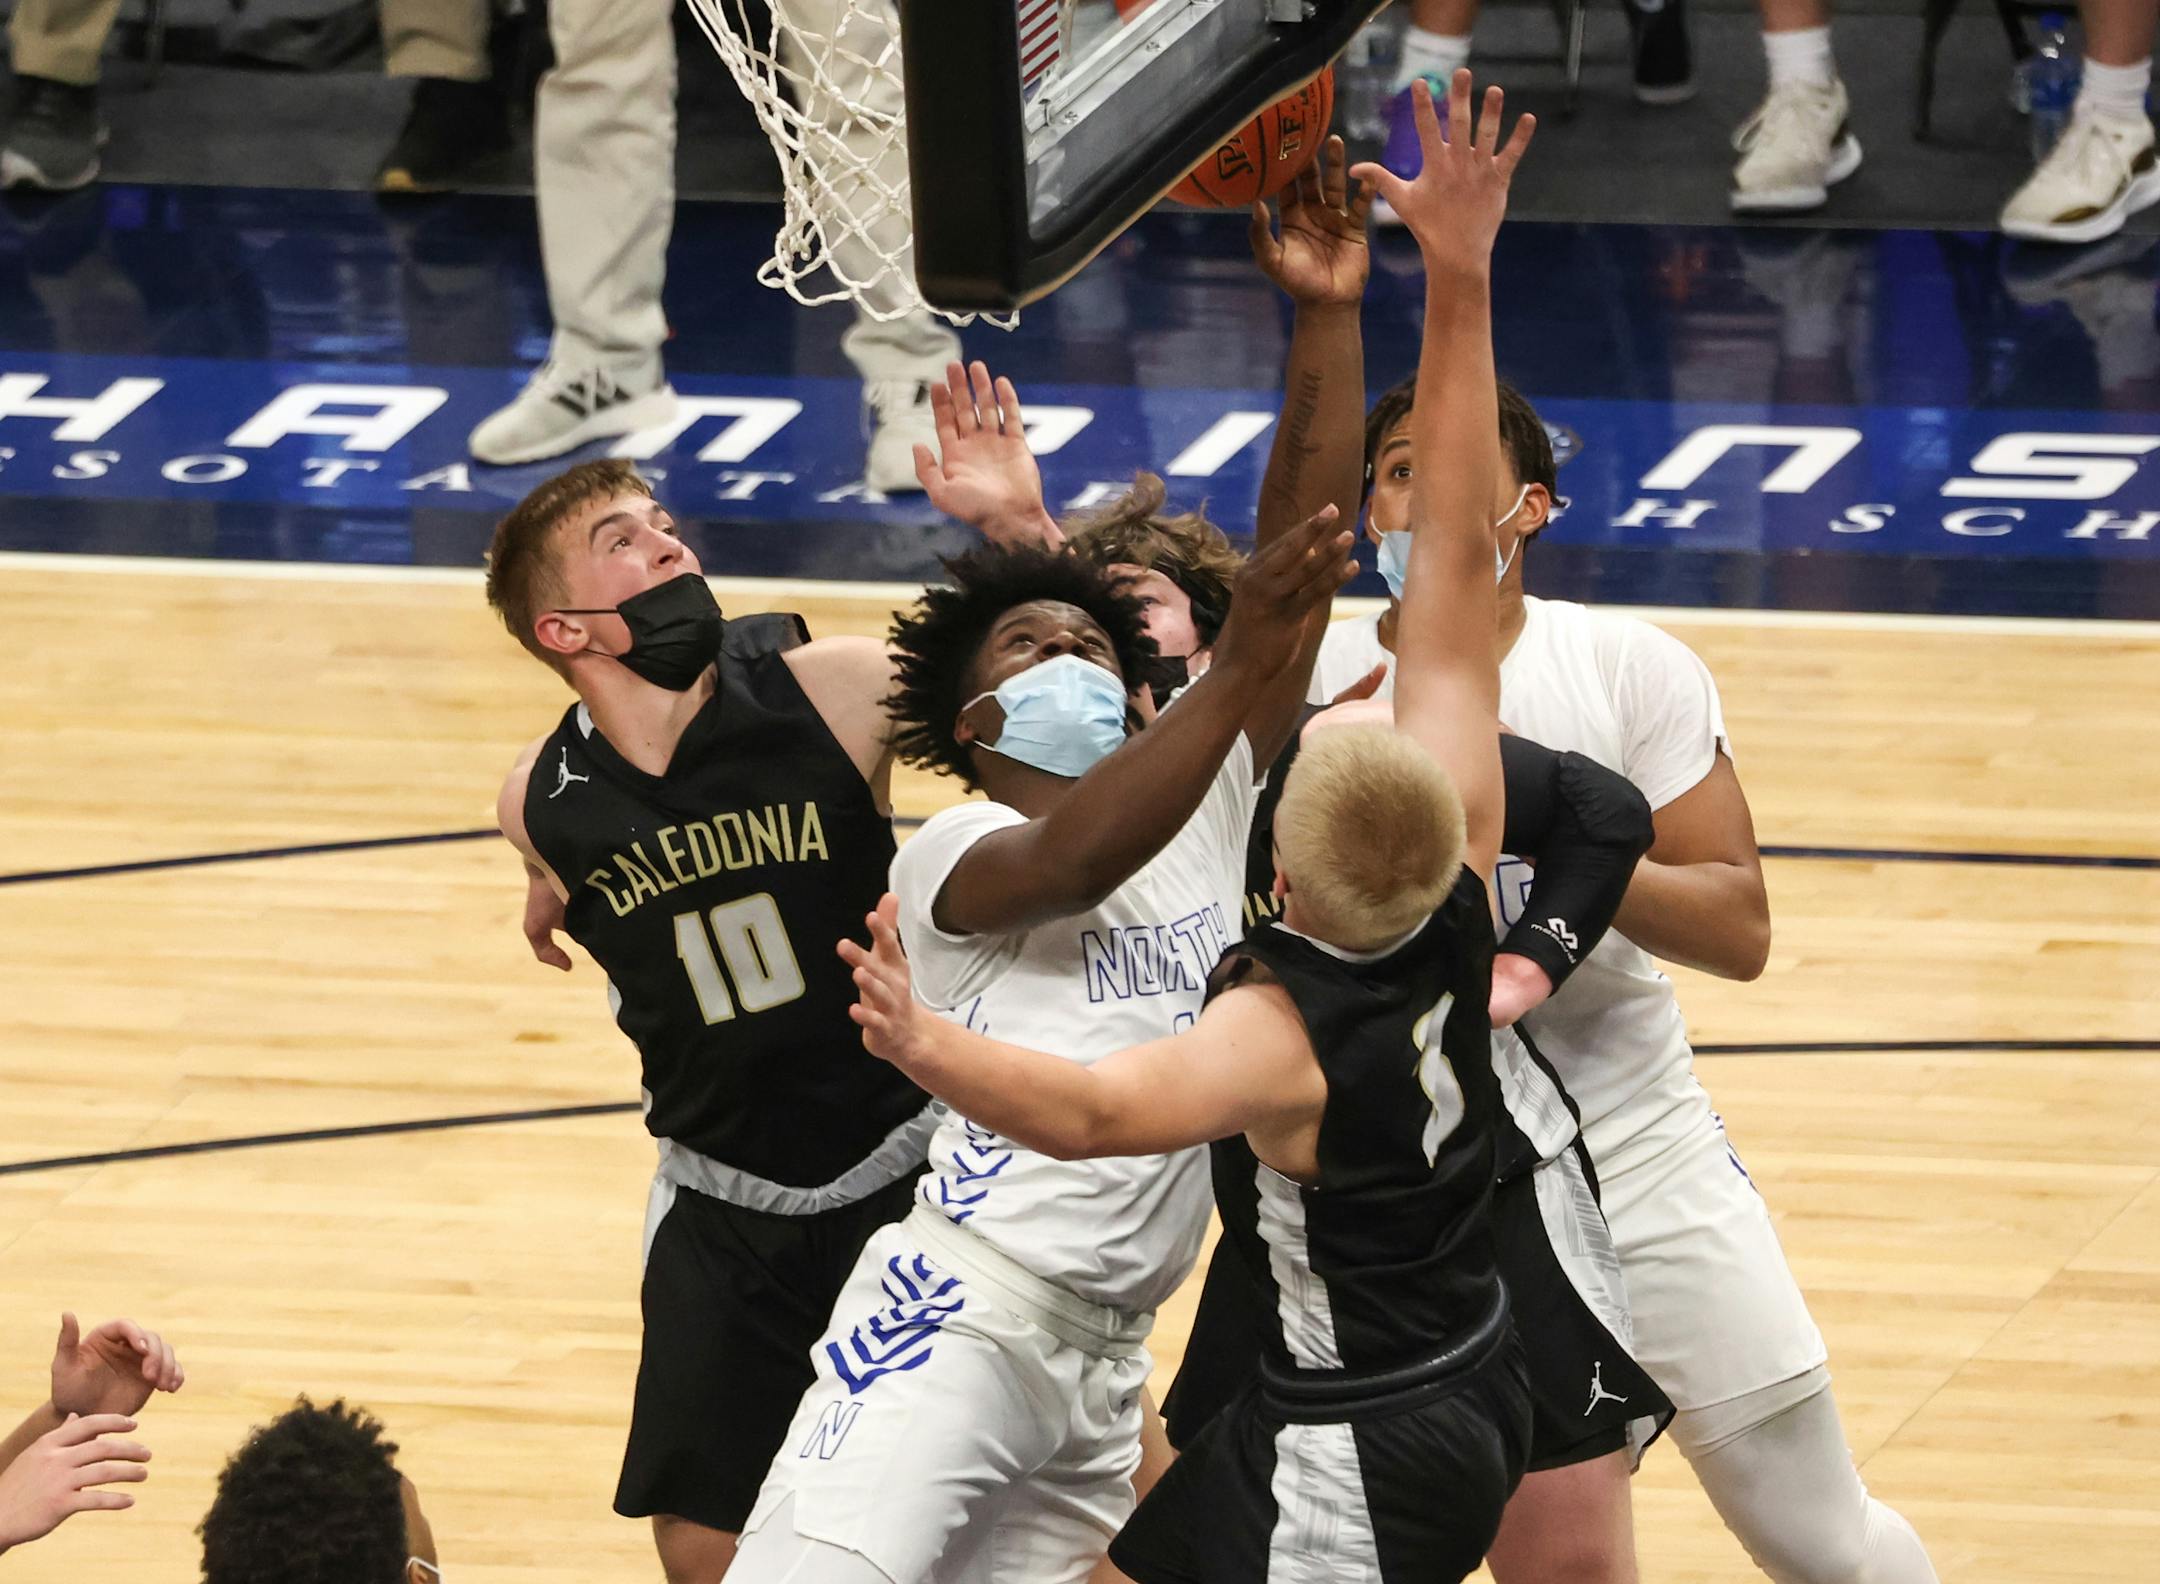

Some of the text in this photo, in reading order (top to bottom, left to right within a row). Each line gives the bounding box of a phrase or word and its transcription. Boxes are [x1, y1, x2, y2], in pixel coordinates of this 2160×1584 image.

[0, 446, 471, 493] SOTA
[585, 801, 830, 918] CALEDONIA
[673, 891, 807, 1026] 10
[1081, 902, 1232, 1003] NORTH
[799, 1400, 864, 1461] N
